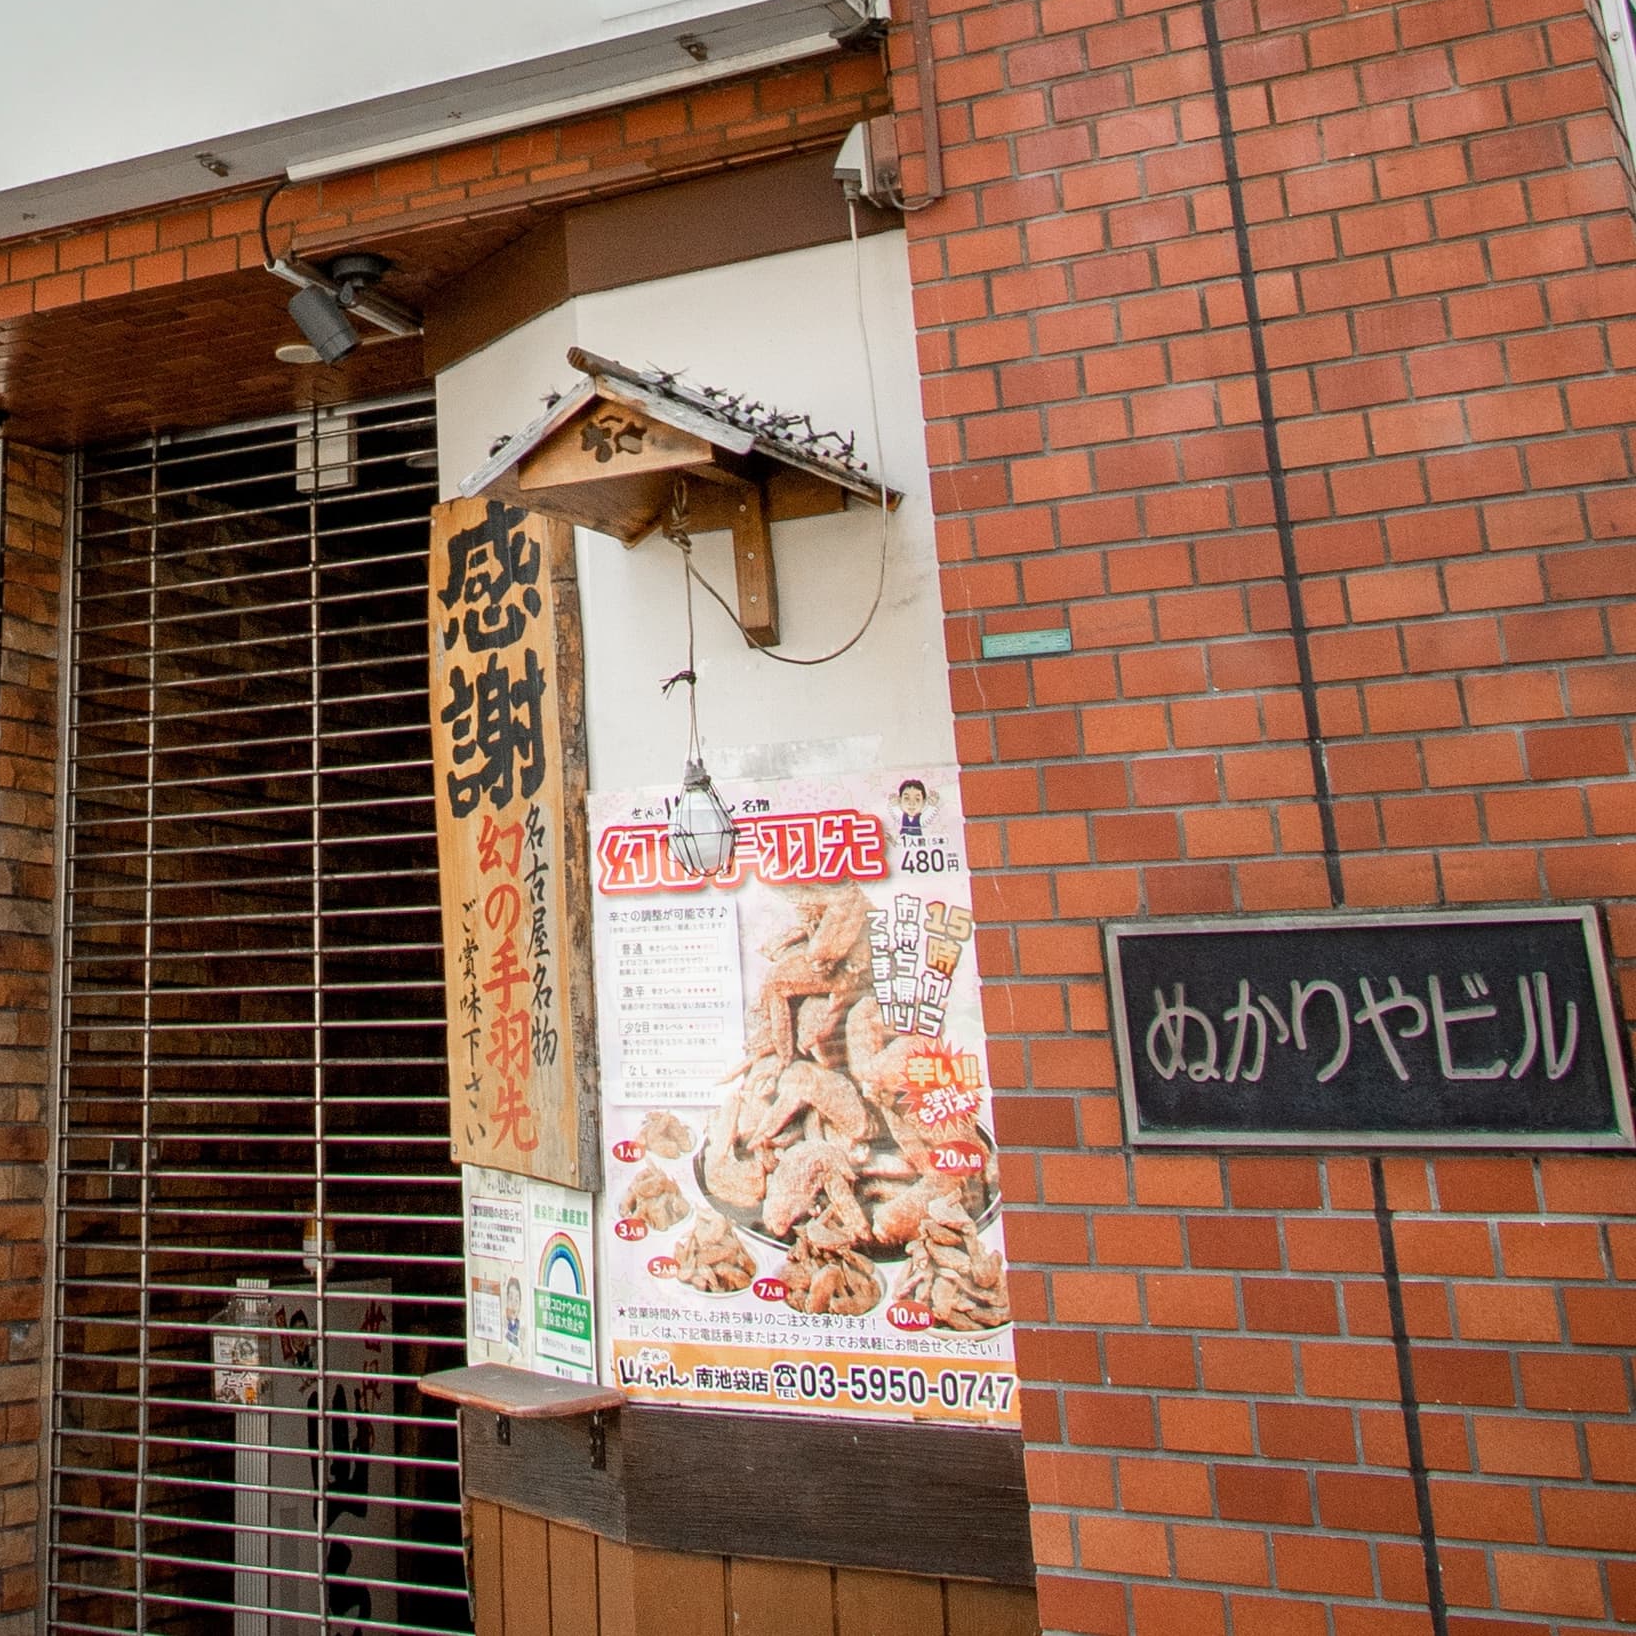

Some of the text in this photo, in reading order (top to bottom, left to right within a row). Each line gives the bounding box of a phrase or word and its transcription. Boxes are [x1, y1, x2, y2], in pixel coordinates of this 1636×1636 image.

[438, 499, 549, 820] 感謝
[742, 799, 770, 812] 名物
[901, 849, 959, 874] 480円
[524, 802, 559, 1068] 名古屋名物
[622, 943, 643, 956] 普通
[893, 893, 921, 1034] お持ち帰り
[917, 900, 973, 1038] 15時から
[477, 814, 539, 1152] 幻の手羽先
[624, 1021, 650, 1034] 少な目
[1145, 971, 1578, 1084] ぬかりやビル
[628, 1064, 649, 1077] なし
[617, 1144, 642, 1160] 1人前
[935, 1149, 982, 1169] 20人前
[619, 1223, 646, 1239] 3人前
[652, 1261, 679, 1277] 5人前
[756, 1282, 786, 1299] 7人前
[890, 1307, 931, 1327] 10人前
[620, 1360, 1014, 1412] 山ちゃん 南池袋店 TEL 03-5950-0747
